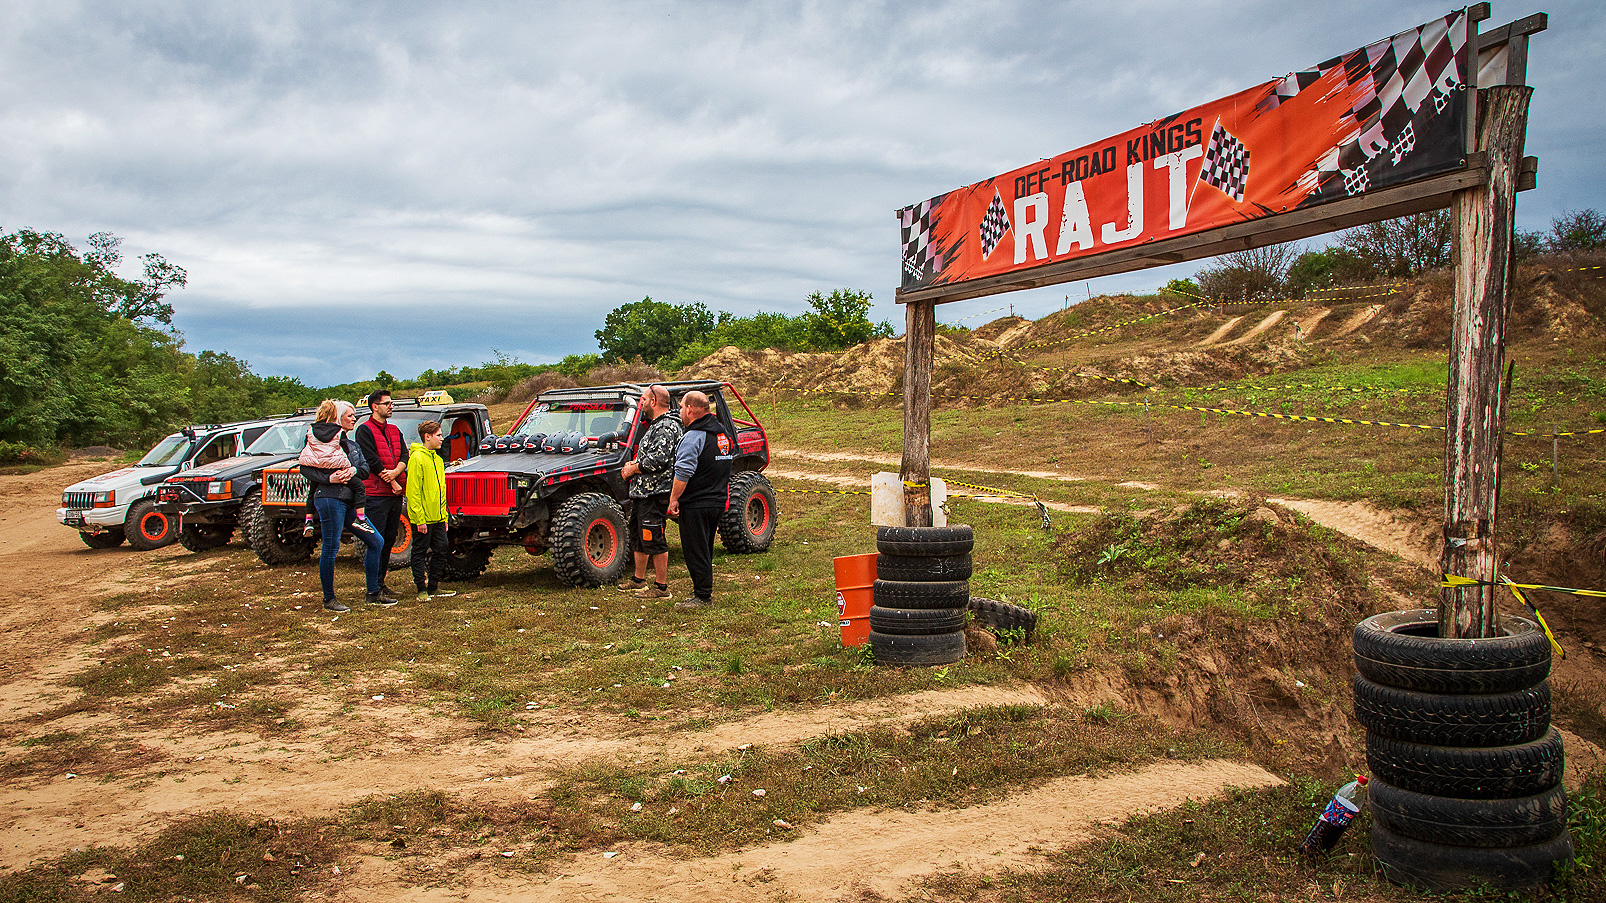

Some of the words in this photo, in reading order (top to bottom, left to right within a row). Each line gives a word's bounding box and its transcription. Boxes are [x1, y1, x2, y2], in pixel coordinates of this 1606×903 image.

[1013, 143, 1204, 265] RAJT
[1014, 145, 1117, 200] OFF-ROAD
[1126, 117, 1203, 165] KINGS
